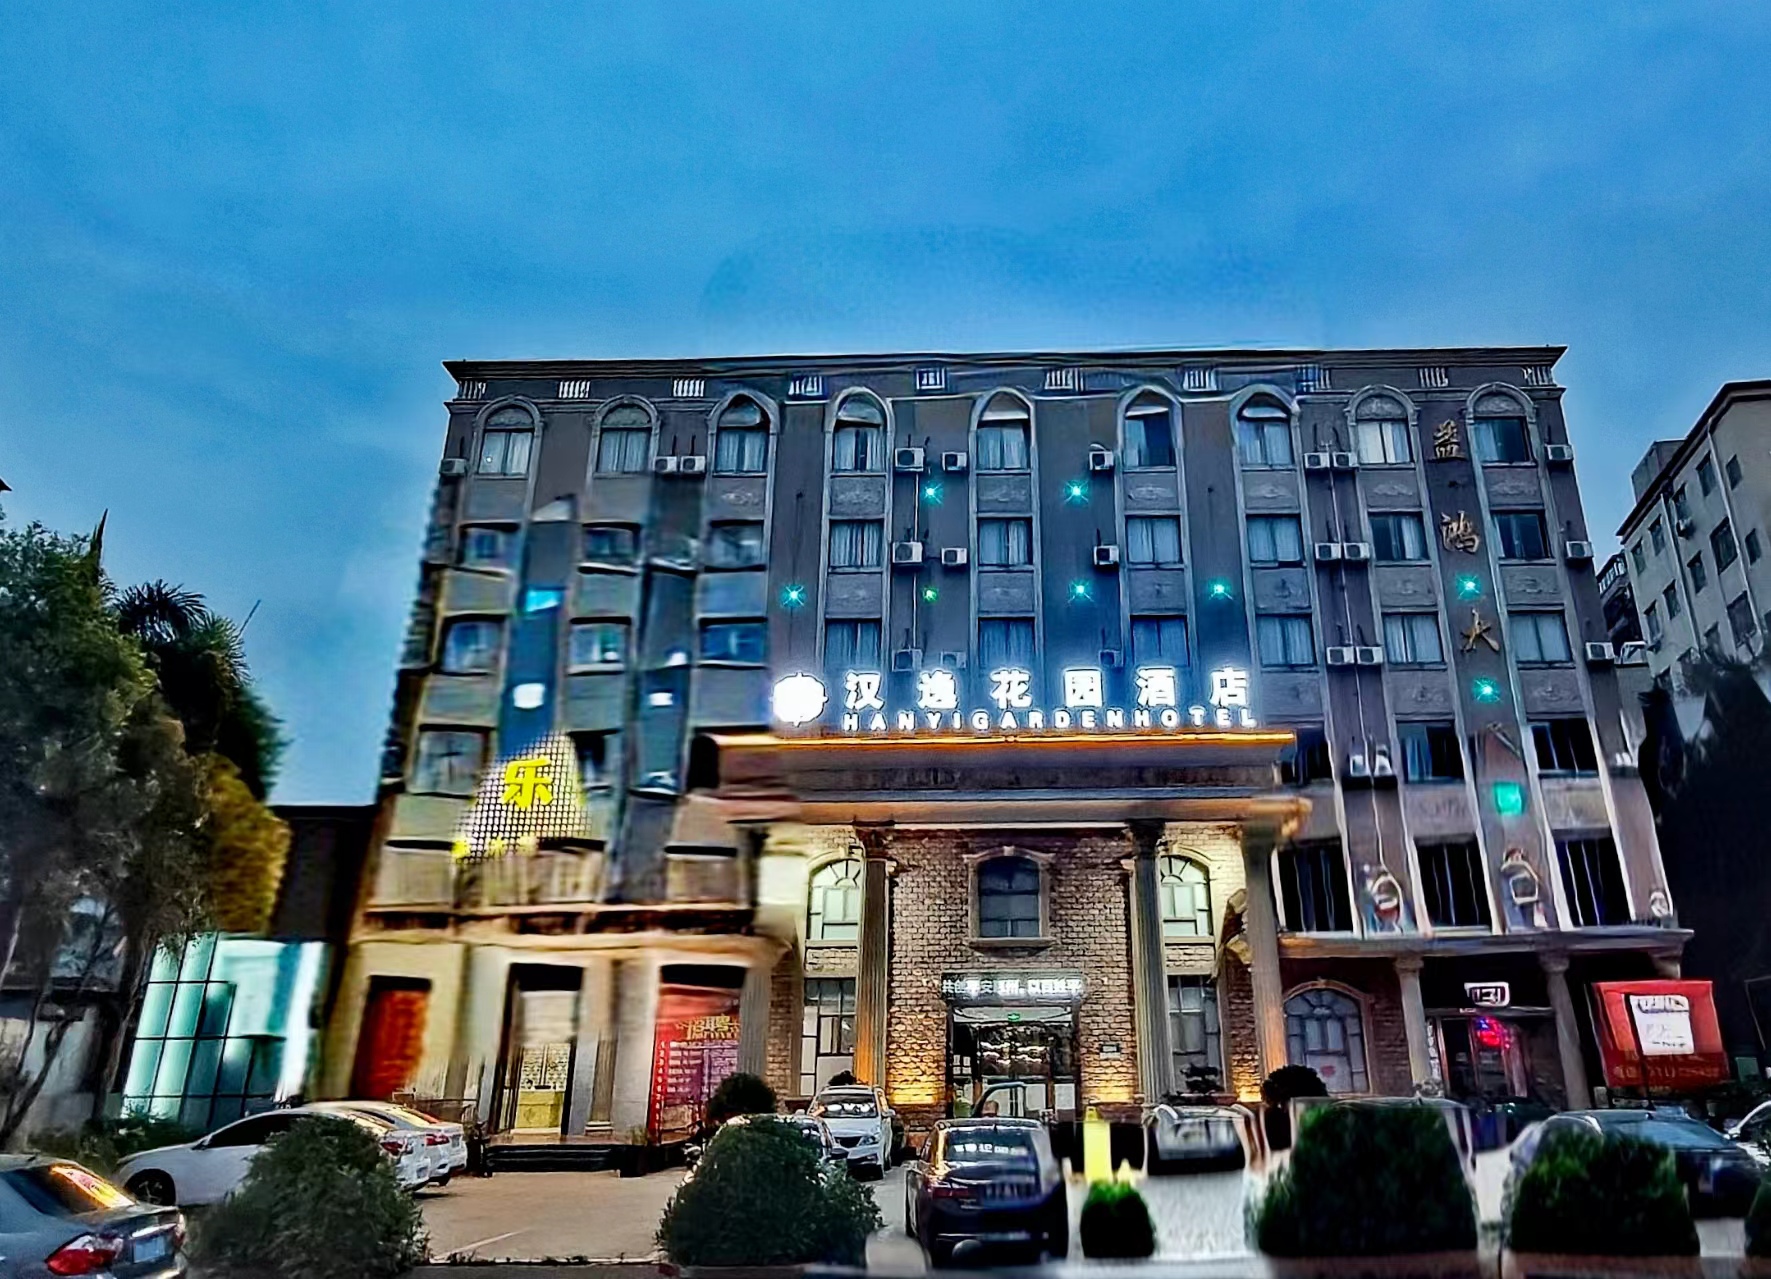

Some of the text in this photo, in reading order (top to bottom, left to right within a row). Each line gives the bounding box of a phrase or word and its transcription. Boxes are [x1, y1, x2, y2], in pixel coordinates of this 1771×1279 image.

[844, 667, 1253, 709] 汉逸花园酒店
[502, 755, 553, 808] 乐
